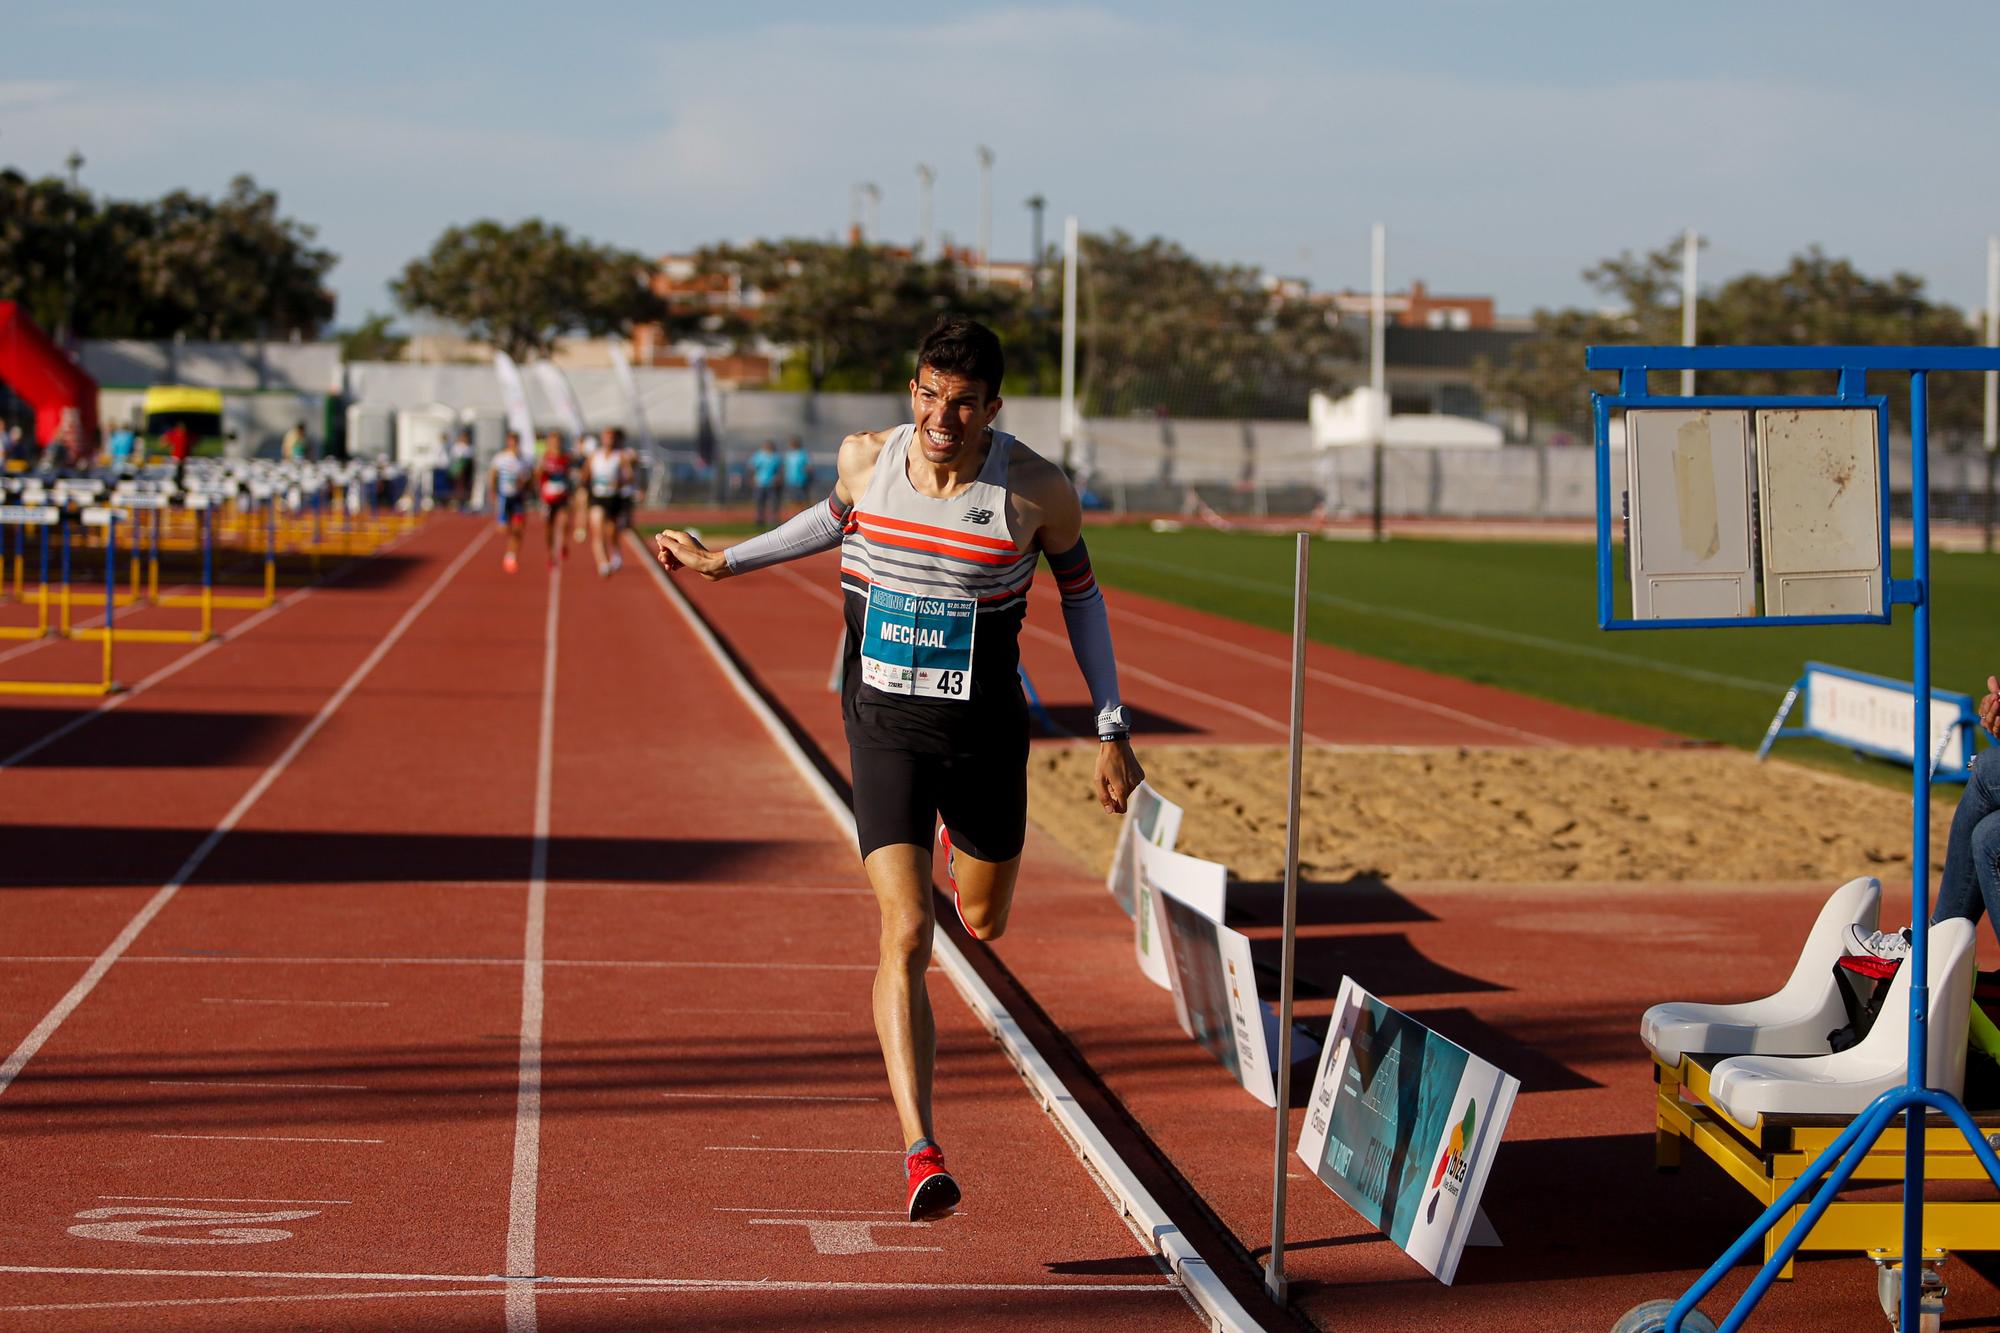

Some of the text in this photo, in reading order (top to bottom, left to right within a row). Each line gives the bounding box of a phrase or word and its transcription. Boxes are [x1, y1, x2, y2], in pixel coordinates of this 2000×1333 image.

[873, 588, 945, 616] MEETING EIVISSA
[880, 621, 947, 649] MECHAAL
[937, 670, 964, 696] 43
[1446, 1147, 1469, 1182] Ibiza
